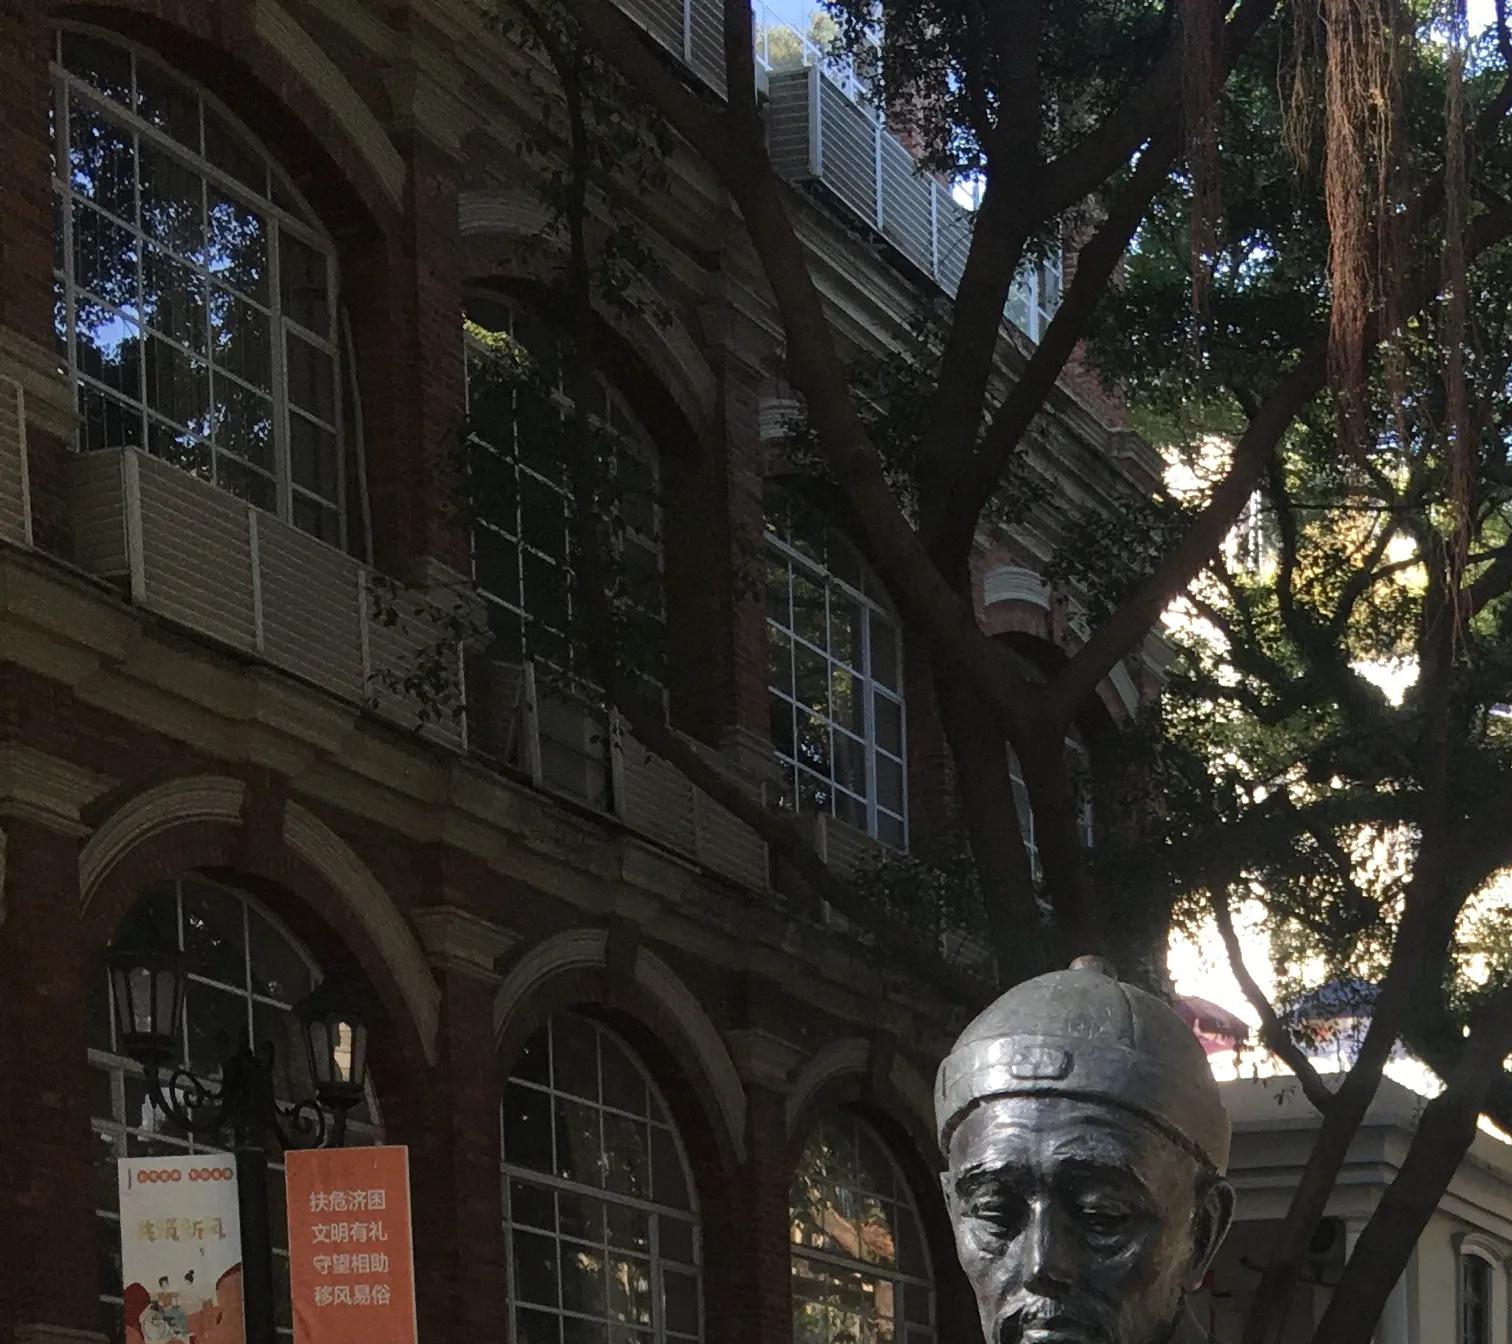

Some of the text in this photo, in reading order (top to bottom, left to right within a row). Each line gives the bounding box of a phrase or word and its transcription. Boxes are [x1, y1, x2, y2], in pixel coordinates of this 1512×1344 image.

[309, 1189, 386, 1212] 扶危济困
[310, 1220, 388, 1244] 文明有礼
[312, 1252, 388, 1275] 守望相助
[314, 1284, 391, 1307] 移风易俗
